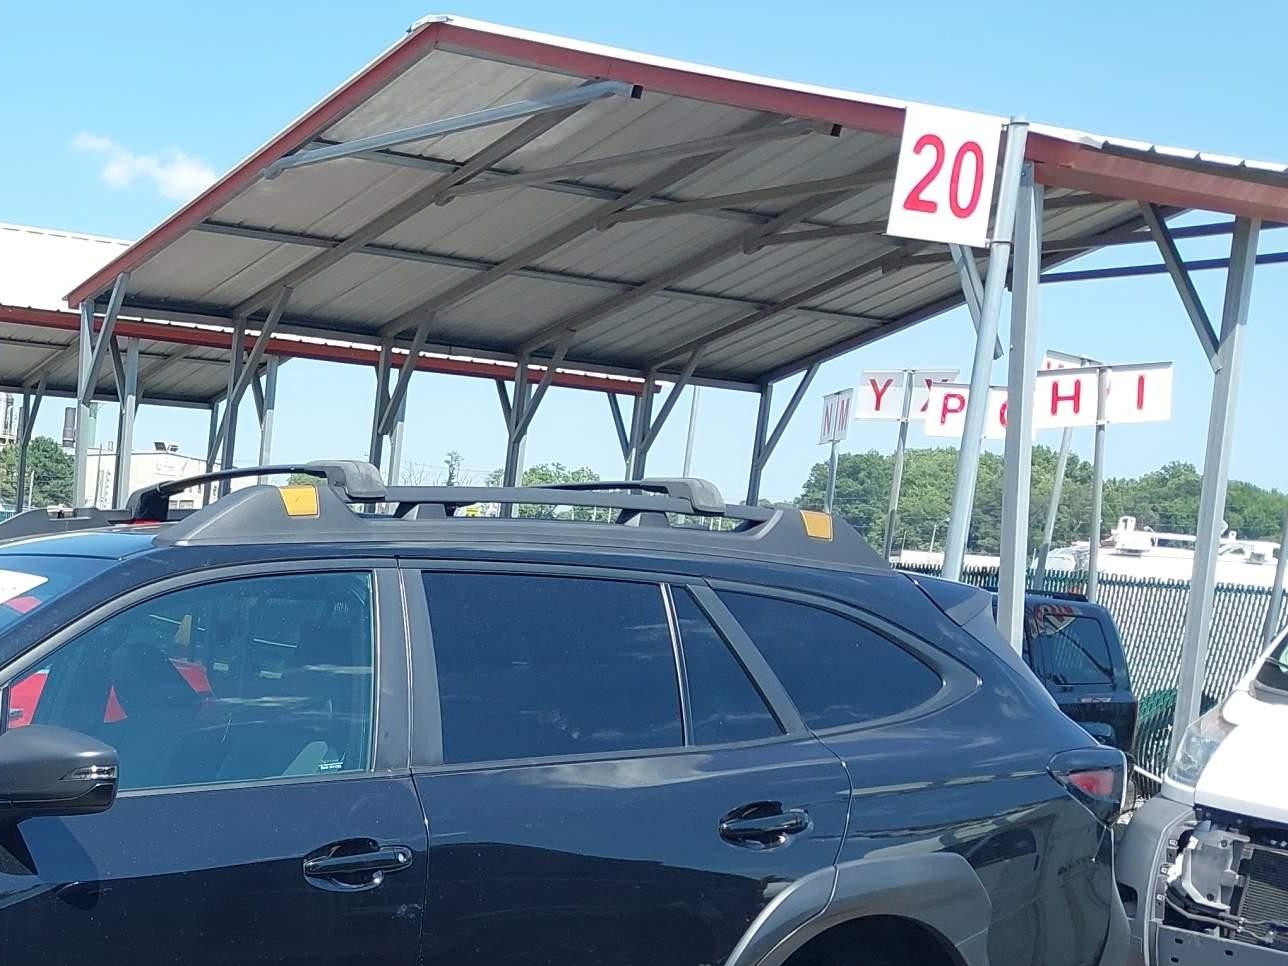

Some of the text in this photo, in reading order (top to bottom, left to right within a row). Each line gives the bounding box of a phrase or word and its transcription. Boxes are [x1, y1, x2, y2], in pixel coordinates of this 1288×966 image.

[903, 134, 983, 218] 20
[870, 378, 893, 411] Y
[940, 393, 966, 425] P
[1051, 380, 1080, 416] H
[1136, 375, 1144, 410] I
